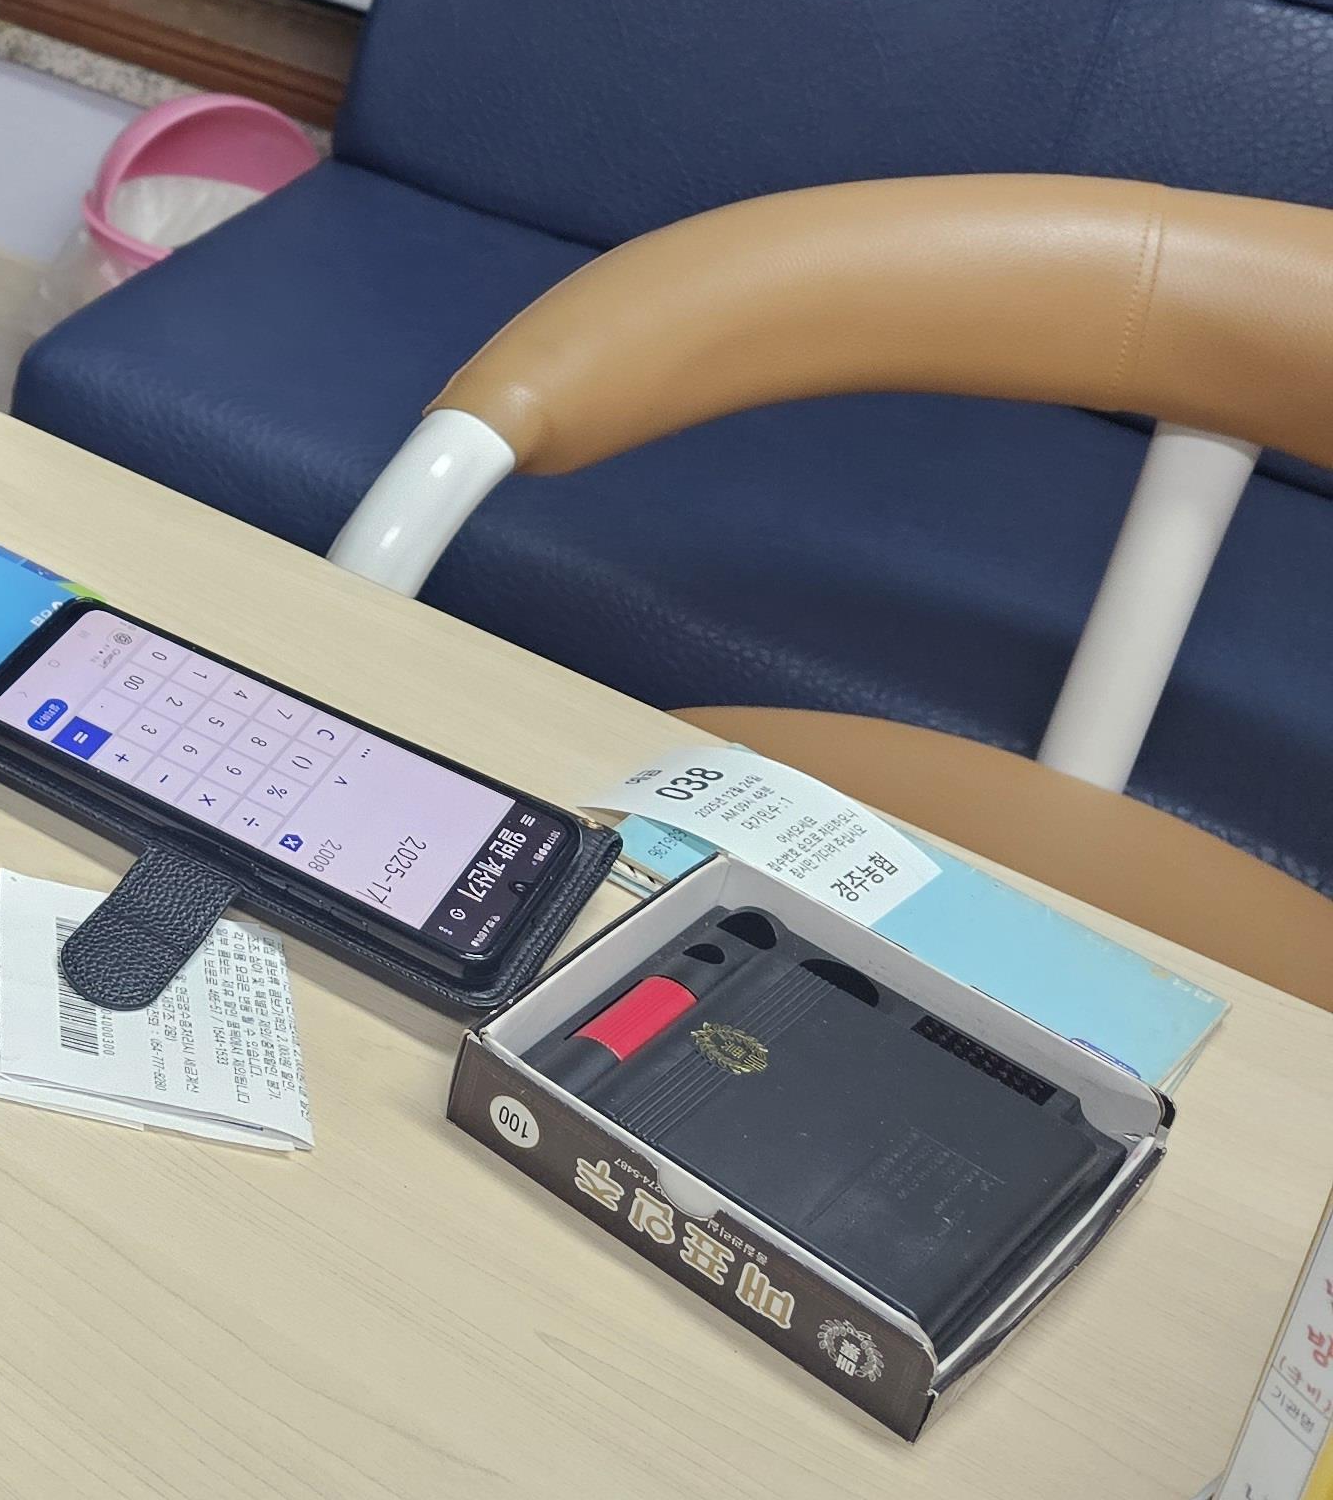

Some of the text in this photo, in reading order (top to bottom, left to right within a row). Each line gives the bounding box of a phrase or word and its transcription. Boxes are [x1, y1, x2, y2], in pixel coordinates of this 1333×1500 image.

[123, 651, 167, 690] 0 00
[141, 671, 207, 735] 1 2 3
[182, 690, 248, 755] 4 5 6
[226, 708, 293, 776] 7 8 9
[317, 729, 335, 741] C
[655, 767, 724, 801] 038
[740, 803, 782, 831] 대기인수
[776, 815, 818, 845] 어서오세요
[308, 839, 342, 873] 2,008
[765, 807, 859, 873] 접수번호 순으로 처리하오니
[788, 823, 868, 879] 잠시만 기다려 주십시오
[366, 835, 427, 907] 2,025-17
[457, 828, 527, 903] 일반 계산기
[829, 850, 898, 902] 경주농협
[233, 943, 246, 961] 이용
[236, 965, 250, 992] 요금은
[213, 1027, 228, 1065] 1544-1533
[498, 1105, 529, 1139] 100
[573, 1157, 796, 1331] 매표인주
